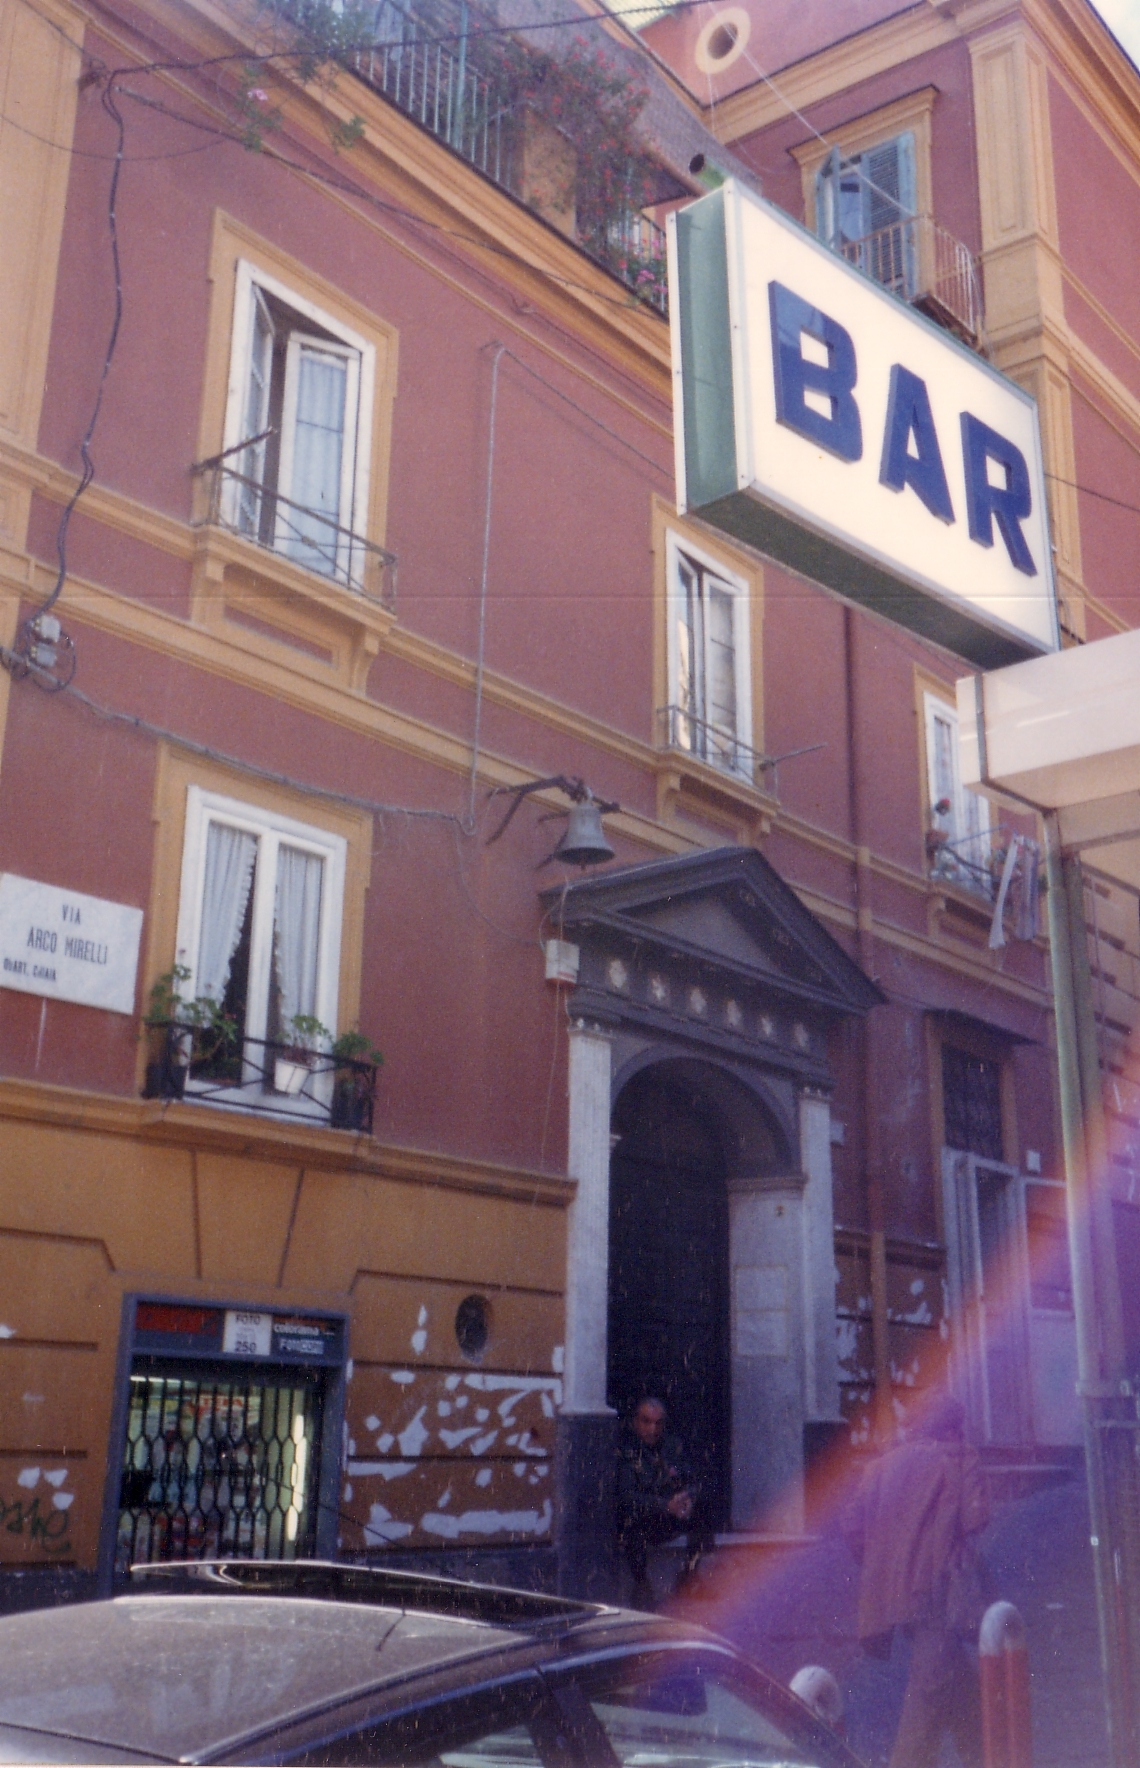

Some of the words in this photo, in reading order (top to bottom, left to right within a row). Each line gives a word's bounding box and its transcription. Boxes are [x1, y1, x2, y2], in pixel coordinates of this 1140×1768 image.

[768, 279, 1037, 577] BAR
[61, 904, 81, 925] VIA
[26, 926, 58, 953] ARCO
[64, 936, 108, 965] MIRELLI
